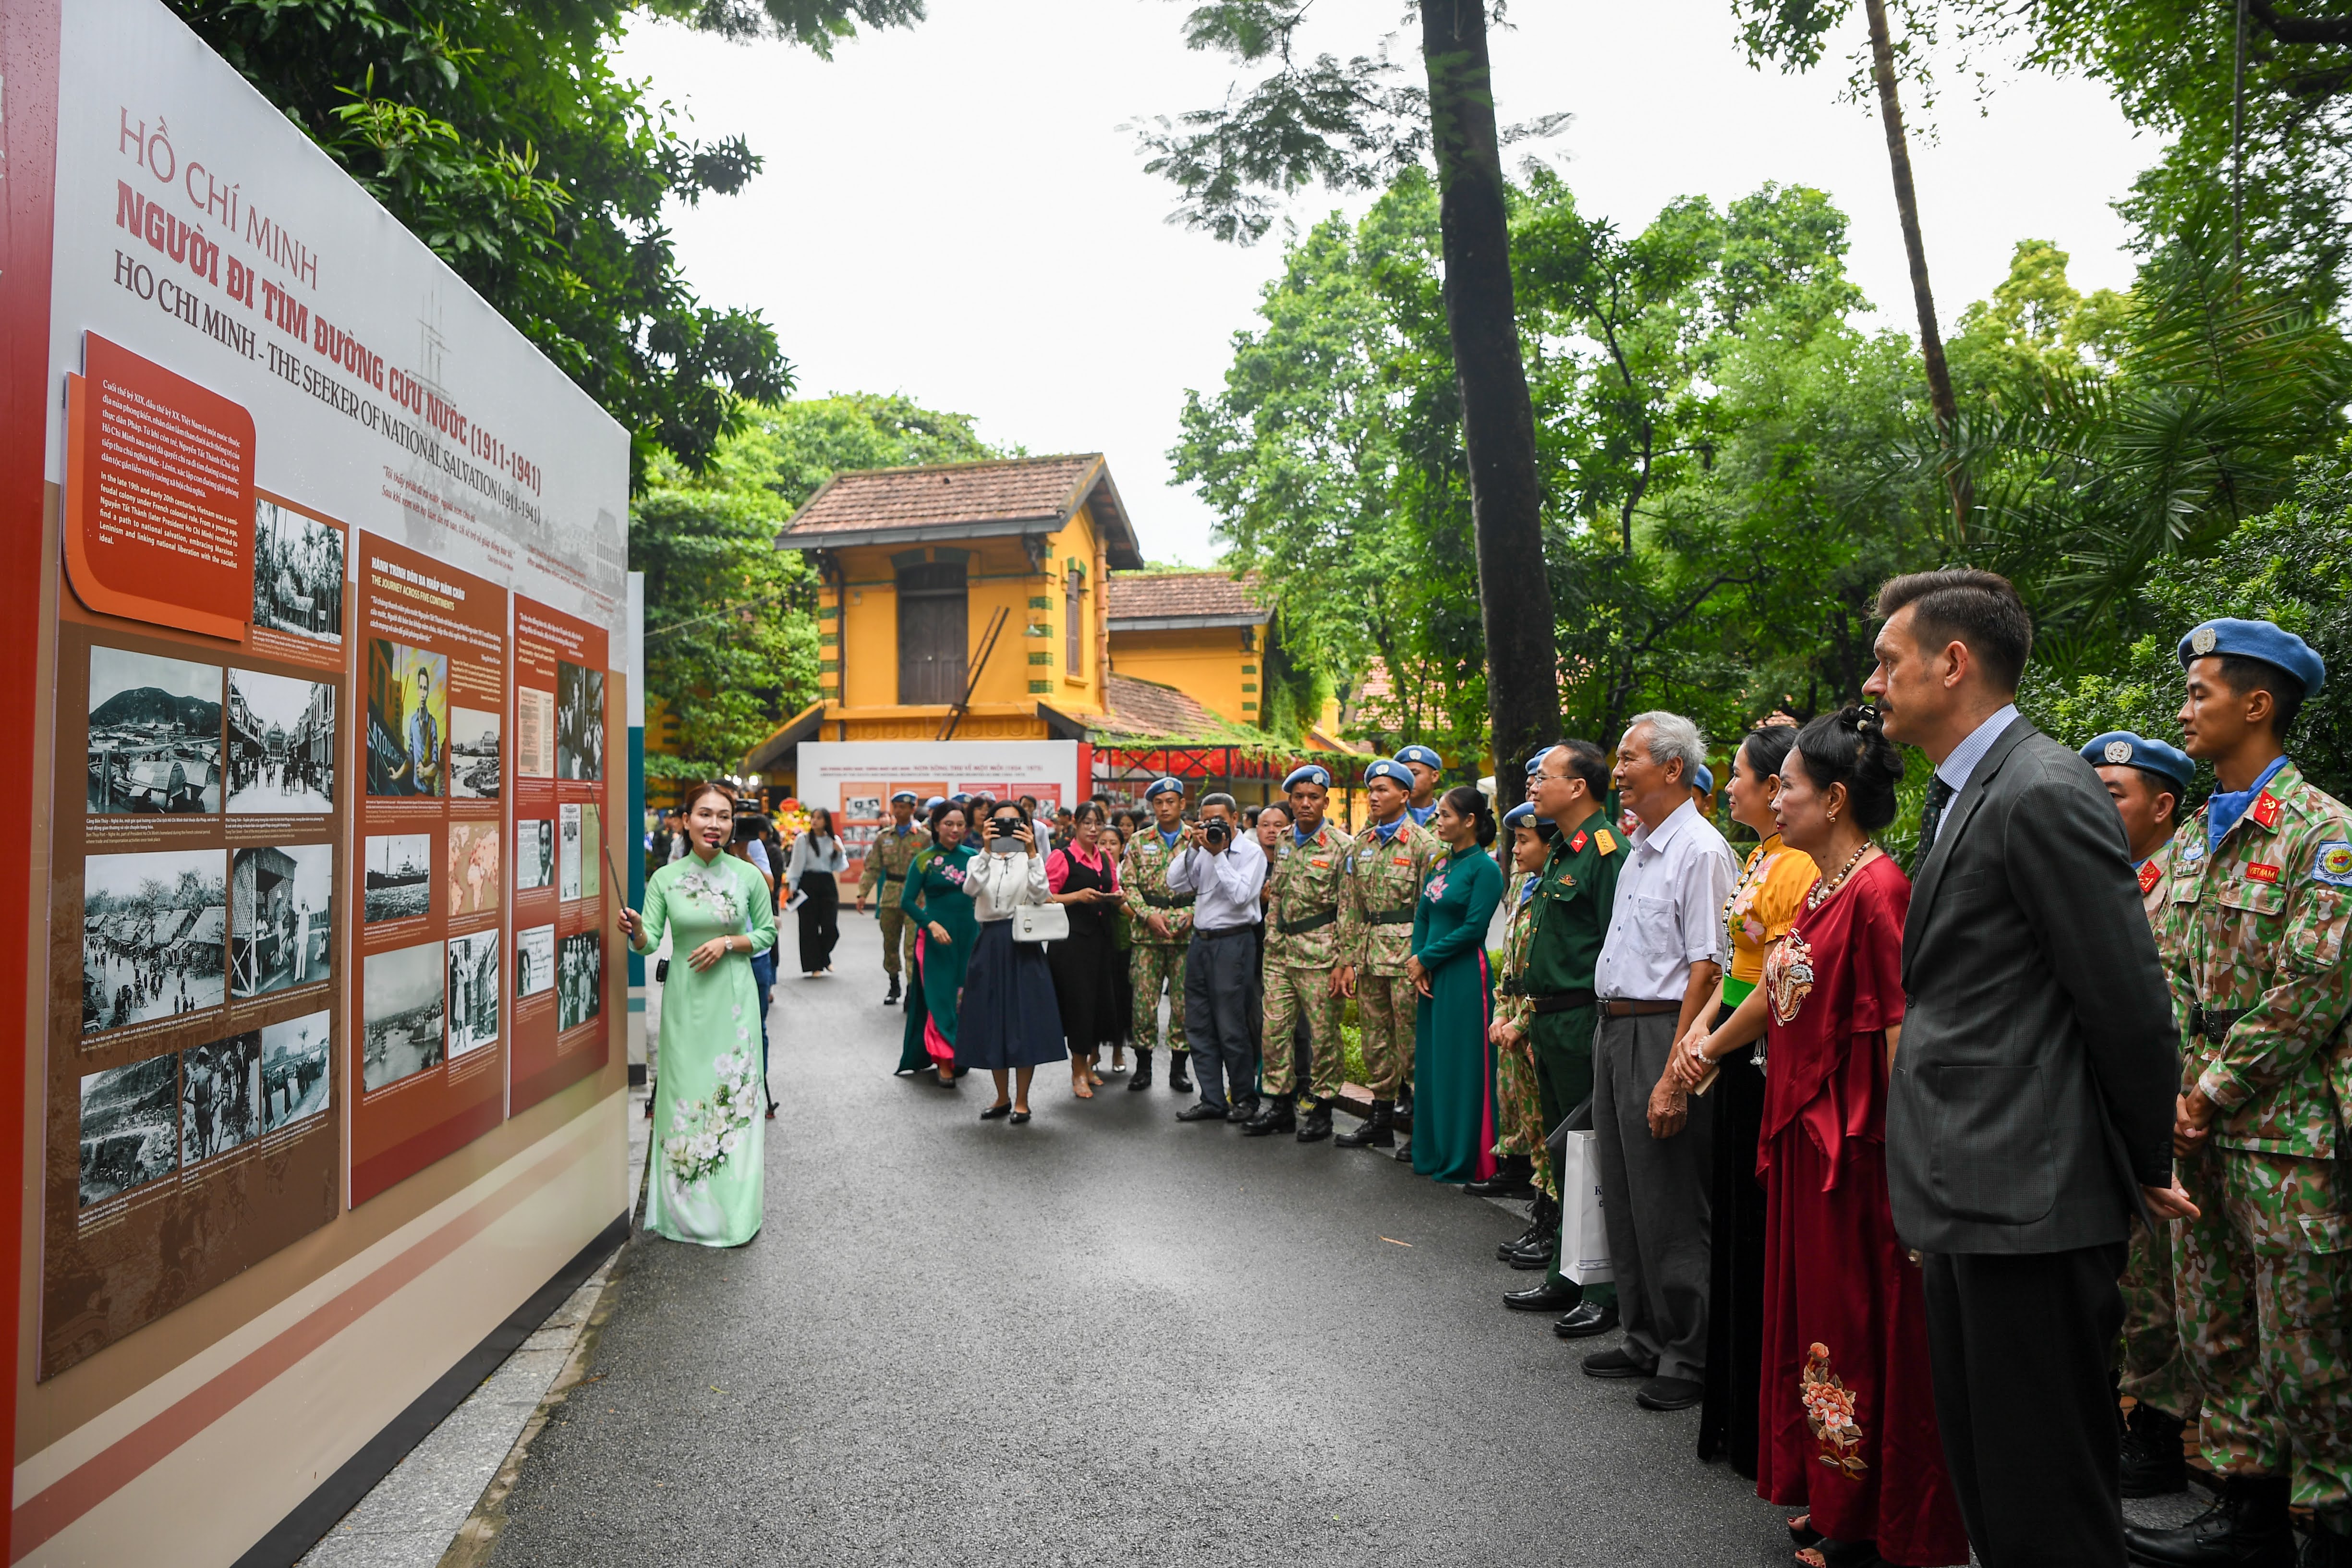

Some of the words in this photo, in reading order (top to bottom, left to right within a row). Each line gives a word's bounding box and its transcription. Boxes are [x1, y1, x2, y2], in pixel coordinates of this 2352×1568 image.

[119, 106, 175, 183] HỒ
[186, 162, 240, 232] CHÍ
[246, 205, 317, 291] MINH
[116, 180, 218, 287] NGƯỜI
[227, 255, 254, 309] ĐI
[262, 278, 308, 343] TÌM
[314, 315, 383, 391] ĐƯỜNG
[389, 367, 423, 415] CỨU
[426, 391, 467, 446] NƯỚC
[471, 424, 540, 497] (1911-1941)
[103, 379, 116, 392] Cuối
[117, 387, 126, 396] thế
[127, 390, 133, 401] kỷ
[134, 393, 145, 406] XIX,
[145, 399, 156, 410] đầu
[156, 404, 165, 413] thế
[165, 407, 171, 418] kỷ
[171, 410, 181, 422] XX,
[181, 414, 191, 425] Việt
[191, 419, 202, 430] Nam
[202, 424, 206, 432] là
[207, 428, 216, 437] một
[114, 249, 154, 300] HO
[158, 279, 198, 328] CHI
[202, 303, 255, 361] MINH
[267, 341, 300, 386] THE
[303, 365, 358, 419] SEEKER
[361, 401, 380, 430] OF
[382, 411, 441, 468] NATIONAL
[443, 450, 497, 499] SALVATION
[498, 483, 540, 527] (1911-1941)
[102, 394, 111, 405] địa
[112, 399, 122, 409] nửa
[123, 404, 140, 418] phong
[140, 410, 152, 423] kiến,
[152, 417, 165, 427] nhân
[165, 422, 175, 432] dân
[184, 430, 195, 440] than
[206, 439, 214, 449] ách
[102, 409, 115, 421] thực
[116, 414, 126, 425] dân
[127, 418, 142, 433] Pháp.
[151, 428, 159, 439] khi
[159, 434, 169, 443] còn
[179, 440, 196, 454] Nguyễn
[206, 451, 219, 464] Thành
[231, 463, 239, 472] tịch
[102, 422, 110, 433] Hồ
[111, 426, 121, 438] Chí
[121, 430, 135, 443] Minh
[135, 438, 145, 447] sau
[163, 450, 177, 460] quyết
[191, 459, 196, 467] đi
[100, 483, 117, 496] feudal
[119, 491, 135, 504] colony
[137, 498, 151, 507] under
[152, 501, 169, 513] French
[170, 509, 188, 520] colonial
[188, 515, 199, 523] rule.
[199, 517, 211, 527] From
[215, 524, 228, 535] young
[229, 529, 238, 537] age,
[101, 471, 106, 480] In
[107, 474, 116, 483] the
[117, 476, 127, 487] late
[128, 481, 139, 491] 19th
[140, 486, 150, 495] and
[150, 490, 162, 501] early
[163, 493, 174, 503] 20th
[174, 499, 196, 512] centuries,
[197, 505, 215, 518] Vietnam
[99, 533, 114, 544] ideal.
[99, 521, 123, 535] Leninism
[137, 532, 154, 546] linking
[156, 540, 176, 550] national
[177, 544, 199, 557] liberation
[201, 552, 210, 560] with
[220, 559, 237, 569] socialist
[100, 508, 111, 519] find
[119, 516, 131, 525] path
[141, 523, 162, 535] national
[164, 530, 187, 543] salvation,
[189, 538, 213, 552] embracing
[215, 545, 233, 556] Marxism
[131, 506, 146, 518] Thành
[148, 511, 161, 522] (later
[162, 516, 184, 530] President
[185, 523, 192, 532] Ho
[201, 529, 214, 540] Minh)
[215, 535, 232, 545] resolved
[371, 557, 388, 573] HÀNH
[371, 574, 381, 586] THE
[381, 578, 402, 593] JOURNEY
[402, 585, 420, 599] ACROSS
[420, 591, 429, 602] FIVE
[429, 595, 454, 610] CONTINENTS
